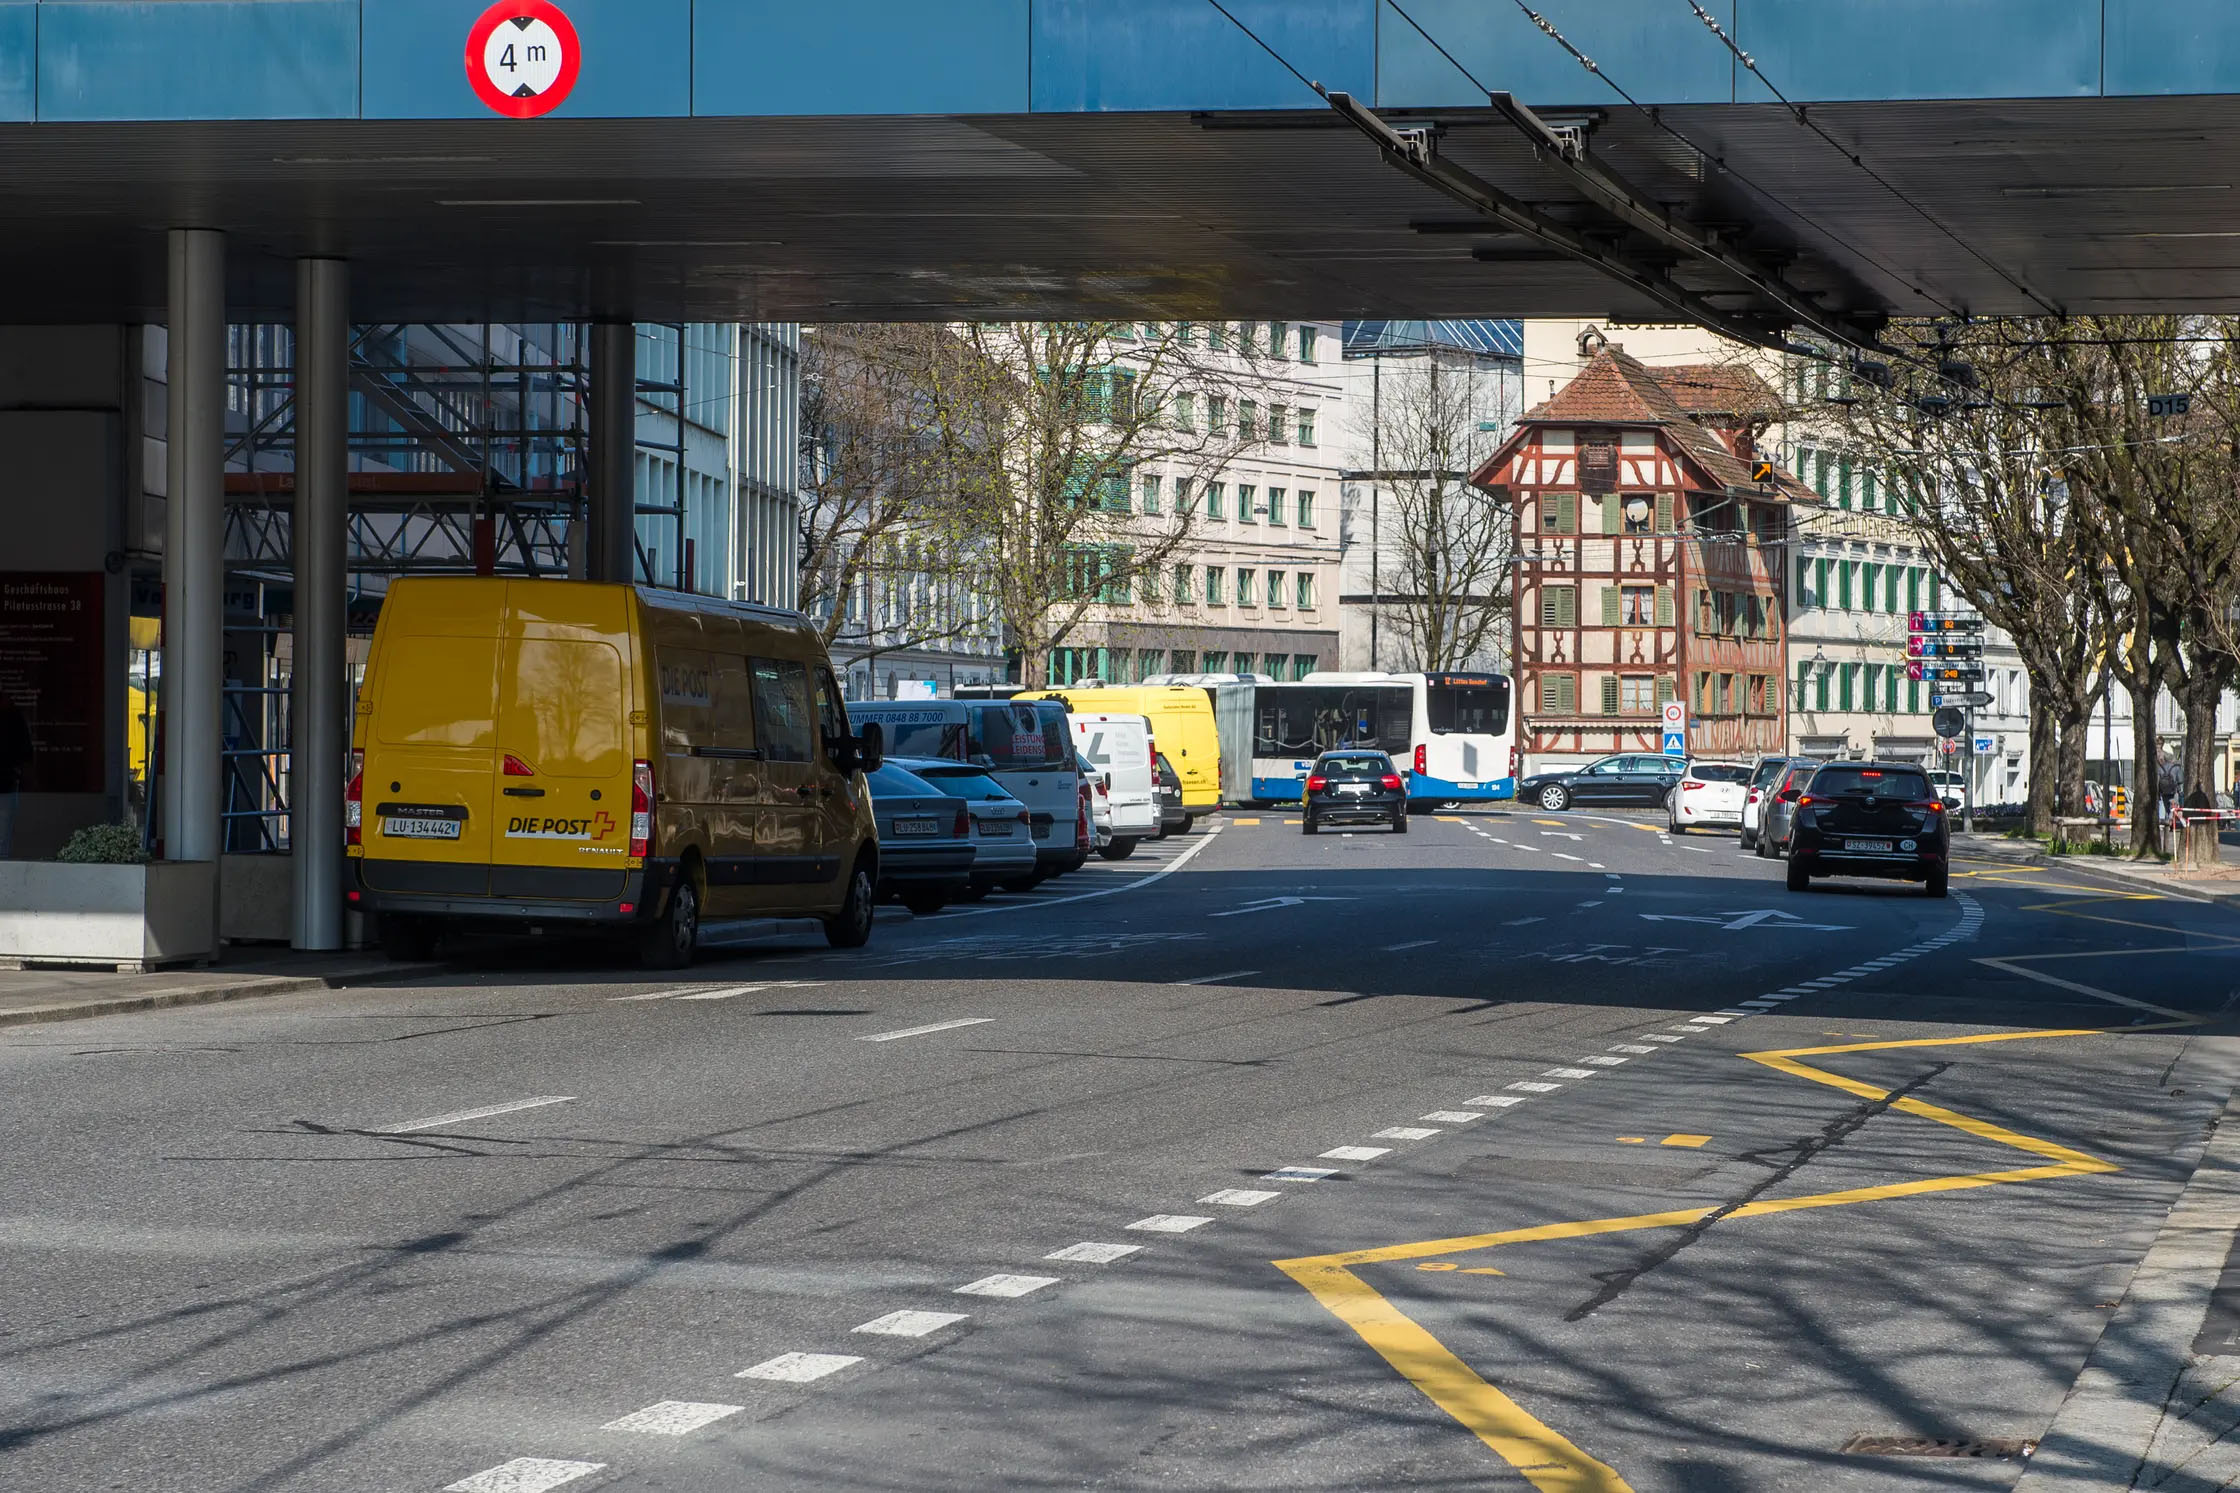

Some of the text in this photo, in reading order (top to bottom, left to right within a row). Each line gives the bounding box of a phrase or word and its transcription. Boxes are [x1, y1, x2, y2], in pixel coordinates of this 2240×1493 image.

[499, 43, 547, 72] 4 m
[2149, 398, 2188, 415] D15
[1811, 511, 1841, 534] HOTEL
[847, 713, 884, 724] UMMER
[885, 713, 907, 723] 0848
[921, 712, 944, 722] 7000
[397, 807, 445, 816] MASTER
[508, 817, 592, 835] DIE POST
